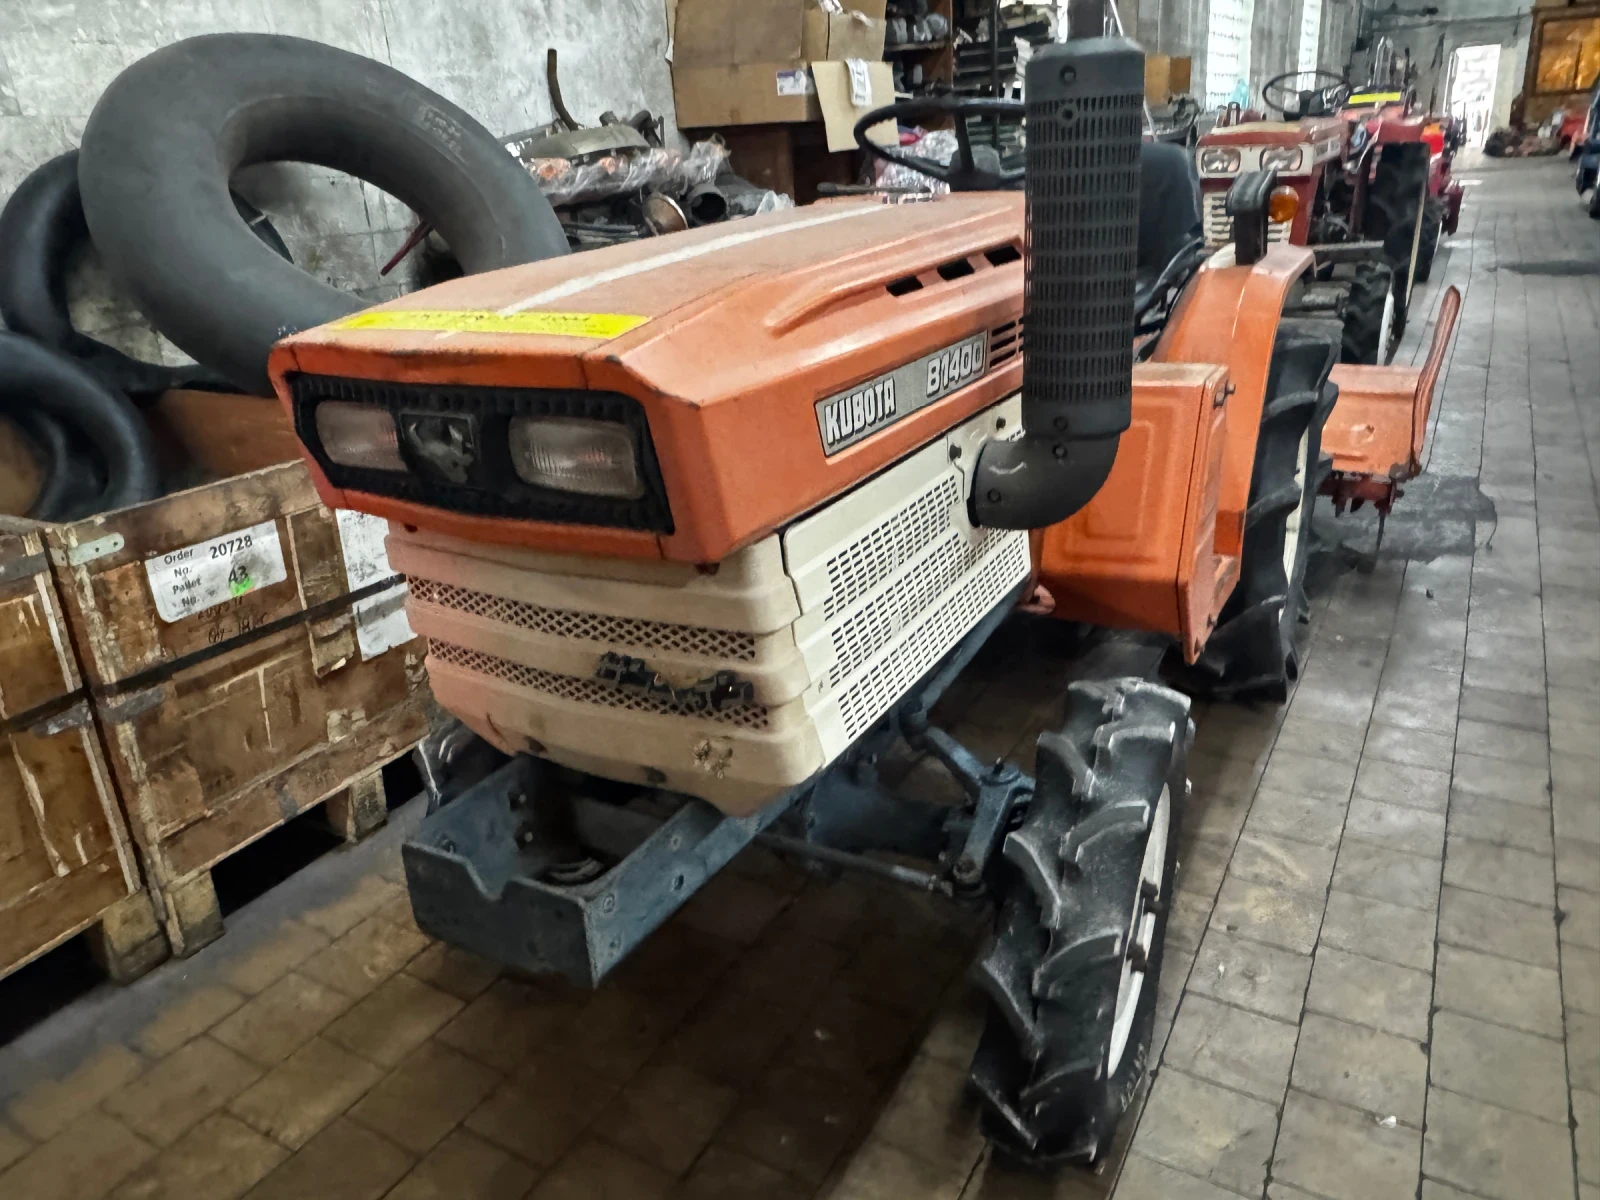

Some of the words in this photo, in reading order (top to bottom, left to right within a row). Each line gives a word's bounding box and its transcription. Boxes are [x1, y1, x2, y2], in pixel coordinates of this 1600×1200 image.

[824, 377, 896, 446] KUBOTA
[926, 340, 986, 398] B1400
[164, 549, 194, 565] Order
[210, 535, 253, 559] 20728
[172, 577, 202, 594] Pallet
[228, 564, 249, 585] 43
[174, 566, 192, 578] No.
[182, 596, 200, 607] No.
